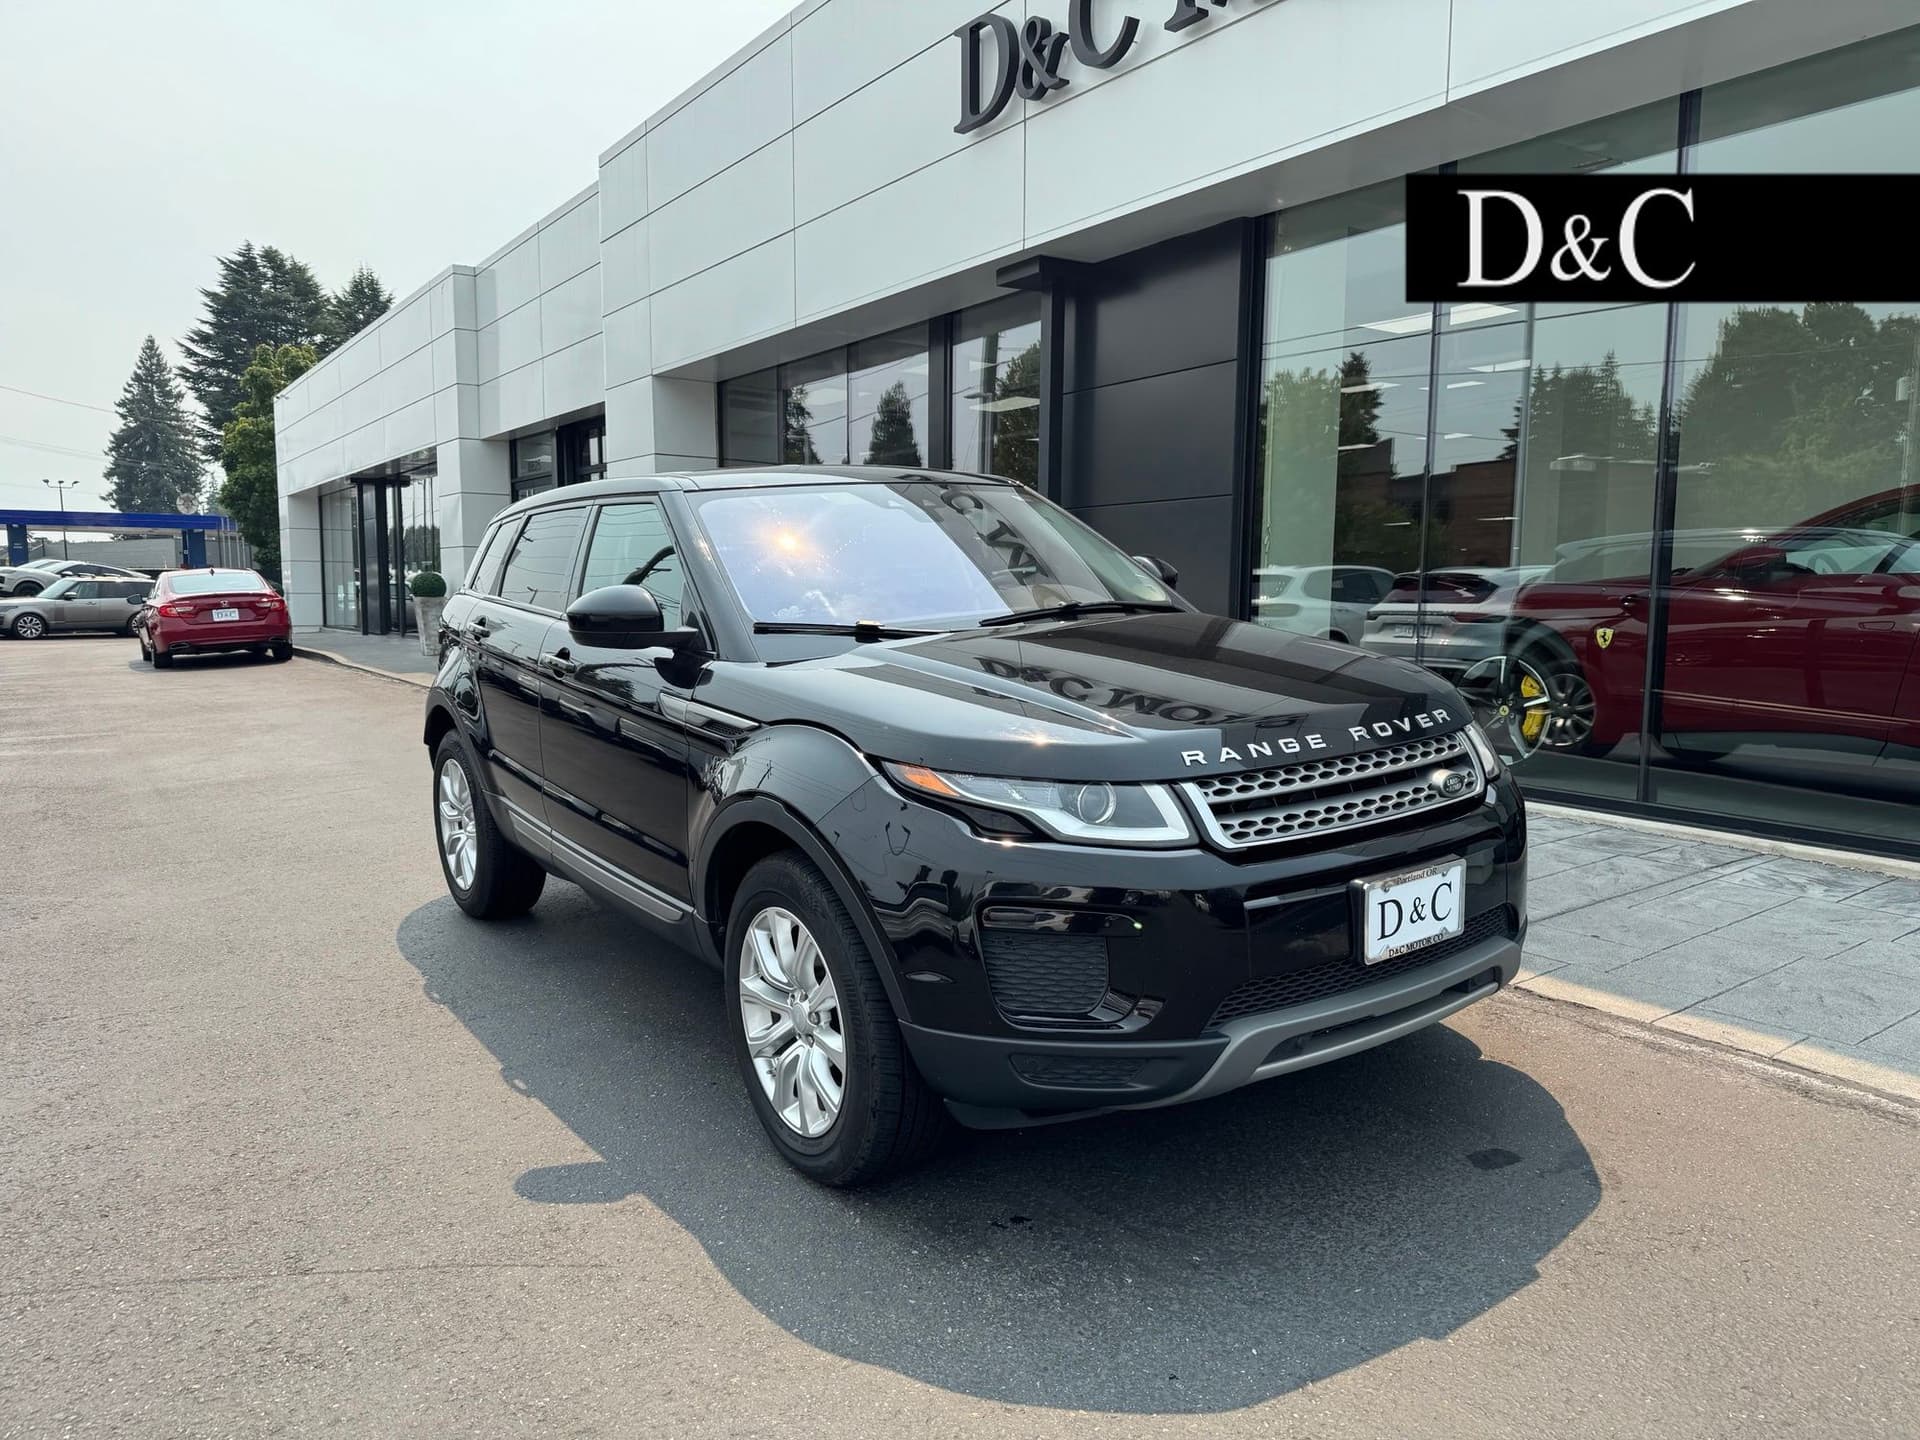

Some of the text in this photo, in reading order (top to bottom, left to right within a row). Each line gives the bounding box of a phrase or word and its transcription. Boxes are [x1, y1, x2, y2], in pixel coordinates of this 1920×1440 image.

[954, 0, 1140, 134] D&C
[1181, 709, 1451, 767] RANGE ROVER
[1396, 870, 1425, 885] Portland
[1389, 933, 1444, 957] D&C MOTOR CO
